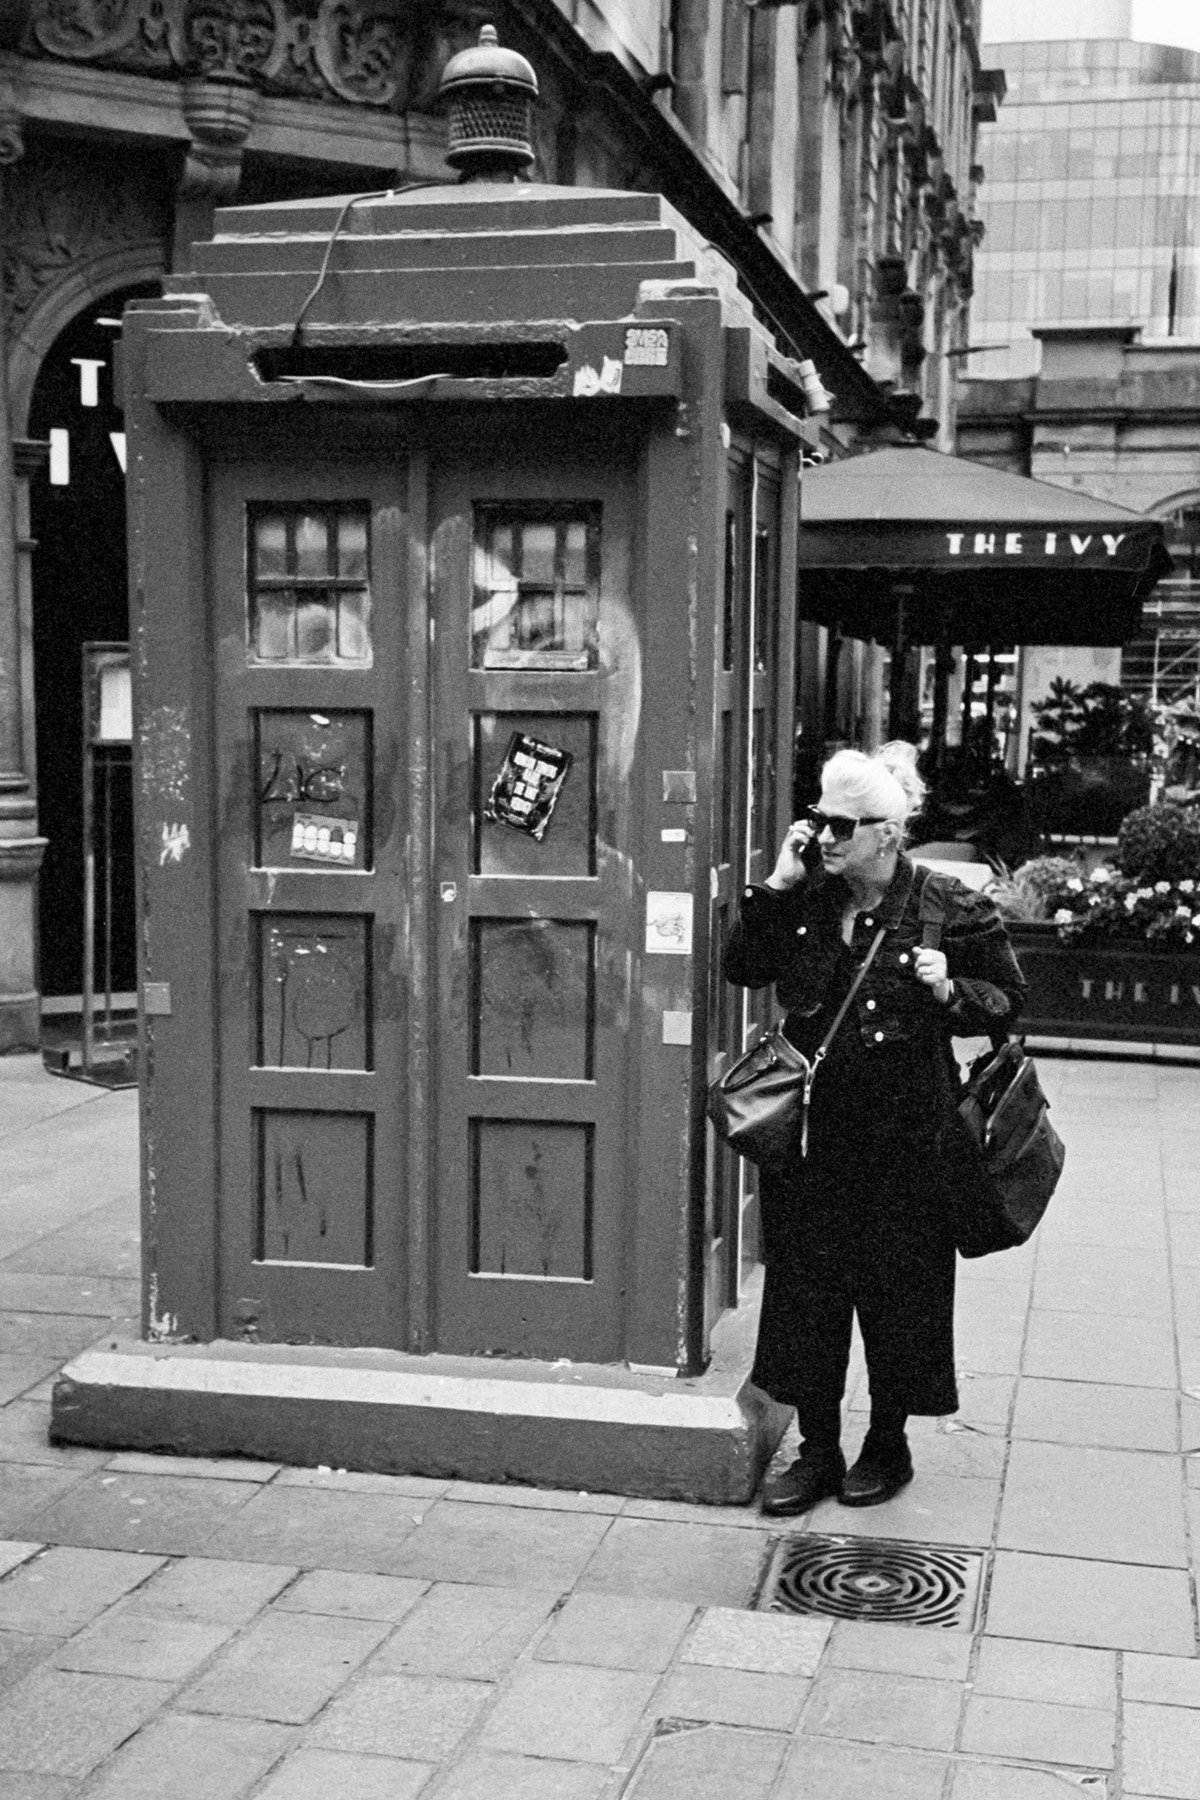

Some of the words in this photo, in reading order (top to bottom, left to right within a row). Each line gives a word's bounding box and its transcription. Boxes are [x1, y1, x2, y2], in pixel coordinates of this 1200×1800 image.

[946, 532, 1023, 555] THE
[1045, 532, 1126, 556] IVY
[1080, 979, 1148, 1002] THE
